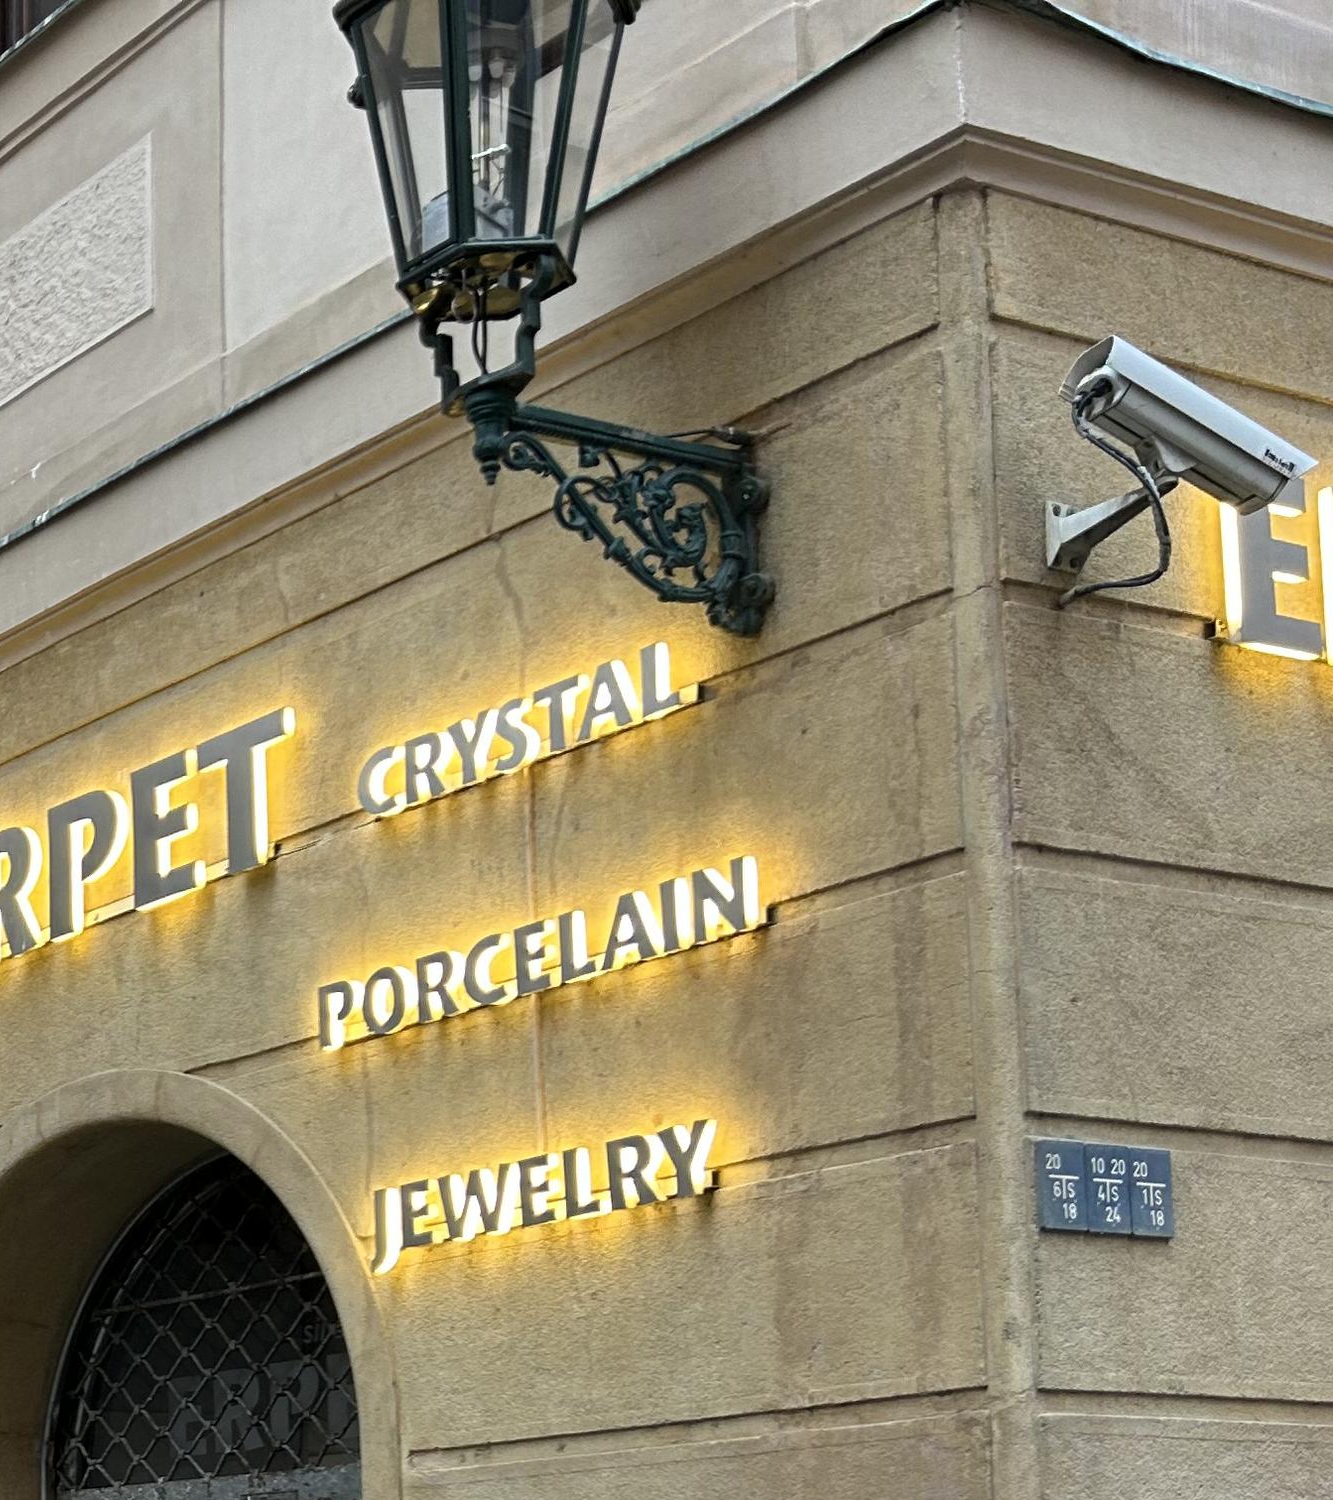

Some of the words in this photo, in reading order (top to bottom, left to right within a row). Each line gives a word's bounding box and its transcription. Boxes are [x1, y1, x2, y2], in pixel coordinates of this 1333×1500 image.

[356, 642, 687, 817] CRYSTAL
[317, 855, 761, 1051] PORCELAIN
[1045, 1153, 1061, 1170] 20
[1091, 1157, 1105, 1174] 10
[1110, 1158, 1126, 1175] 20
[1133, 1161, 1148, 1178] 20
[370, 1119, 717, 1276] JEWELRY
[1052, 1182, 1061, 1198] 6
[1067, 1182, 1076, 1198] S
[1097, 1185, 1105, 1201] 4
[1110, 1186, 1119, 1201] S
[1154, 1190, 1163, 1206] S
[1062, 1202, 1077, 1219] 18
[1105, 1206, 1121, 1223] 24
[1150, 1209, 1165, 1226] 18
